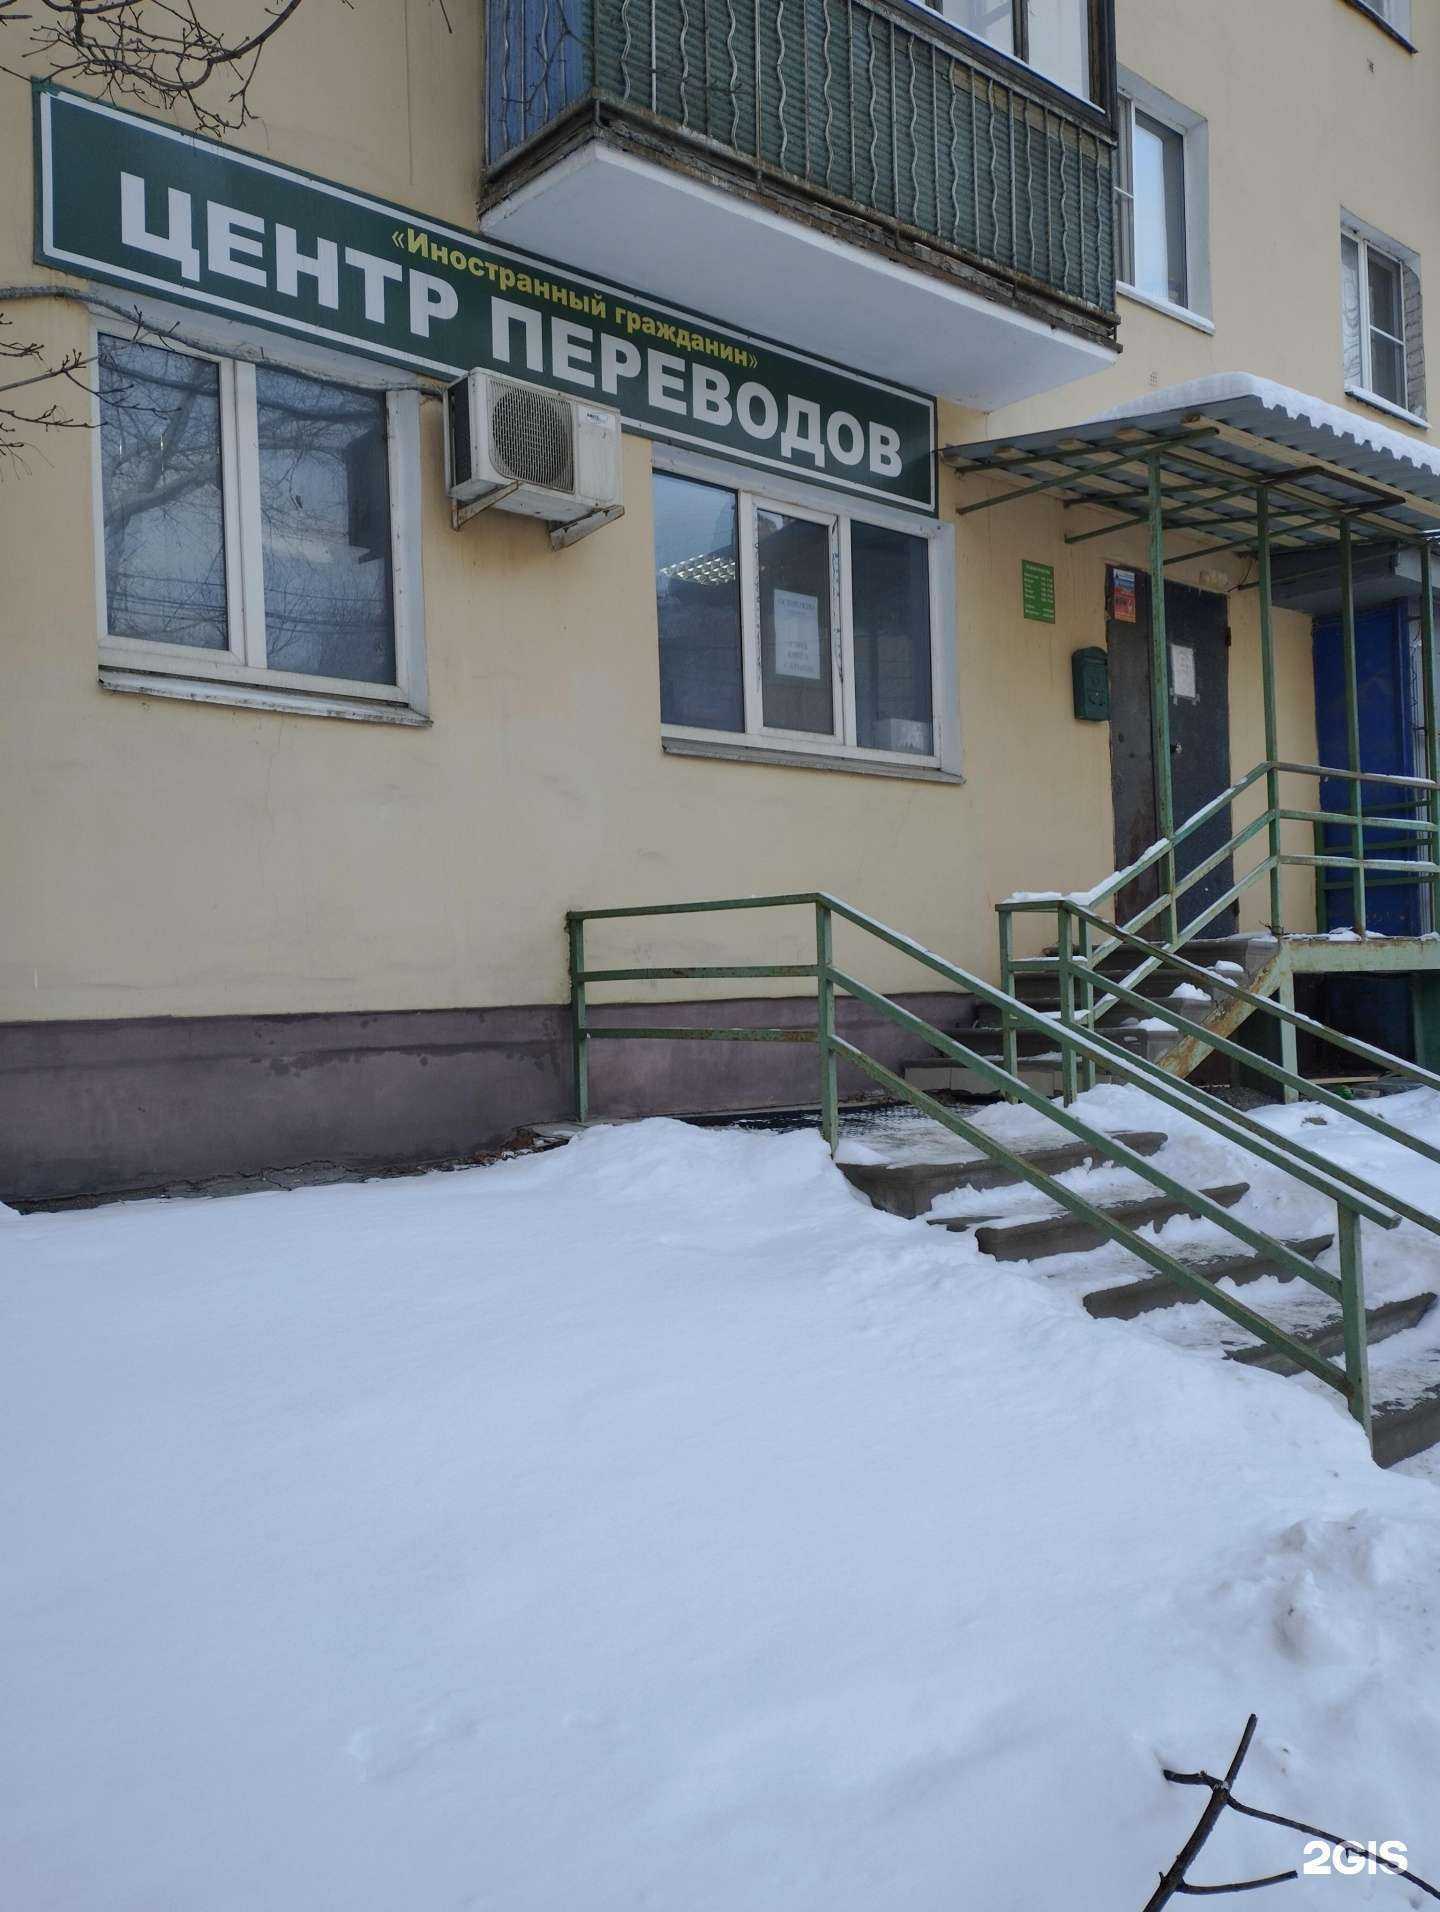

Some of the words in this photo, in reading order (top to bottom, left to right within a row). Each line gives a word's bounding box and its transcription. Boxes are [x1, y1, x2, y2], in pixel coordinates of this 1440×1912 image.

[121, 172, 459, 338] ЦЕНТР
[491, 297, 903, 478] ПЕРЕВОДОВ
[392, 228, 606, 319] «Иностранный
[615, 307, 758, 369] гражданин»
